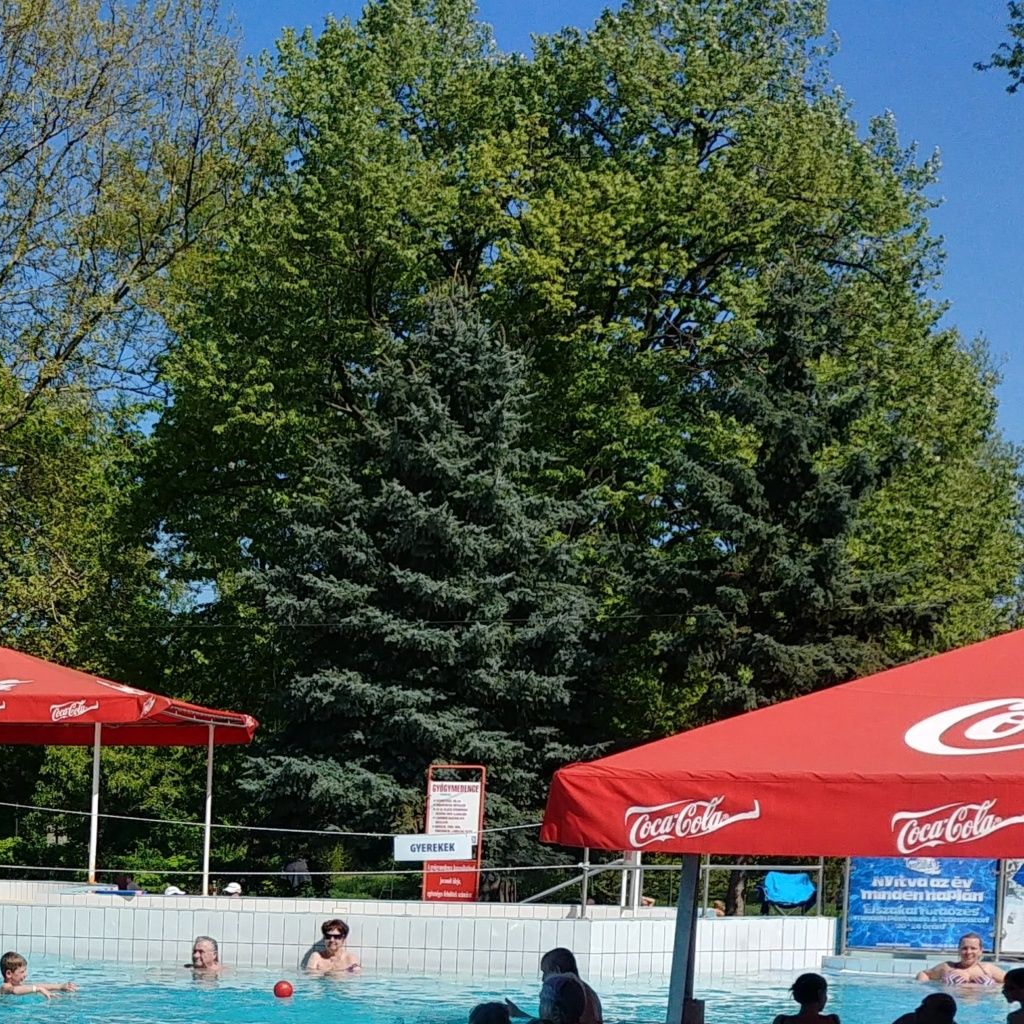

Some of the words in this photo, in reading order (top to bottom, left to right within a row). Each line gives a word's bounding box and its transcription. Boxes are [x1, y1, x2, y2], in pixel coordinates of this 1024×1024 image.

[50, 699, 99, 722] Coca-Cola
[624, 794, 760, 848] Coca-Cola
[891, 799, 1024, 854] Coca-Cola
[410, 843, 455, 853] GYEREKEK
